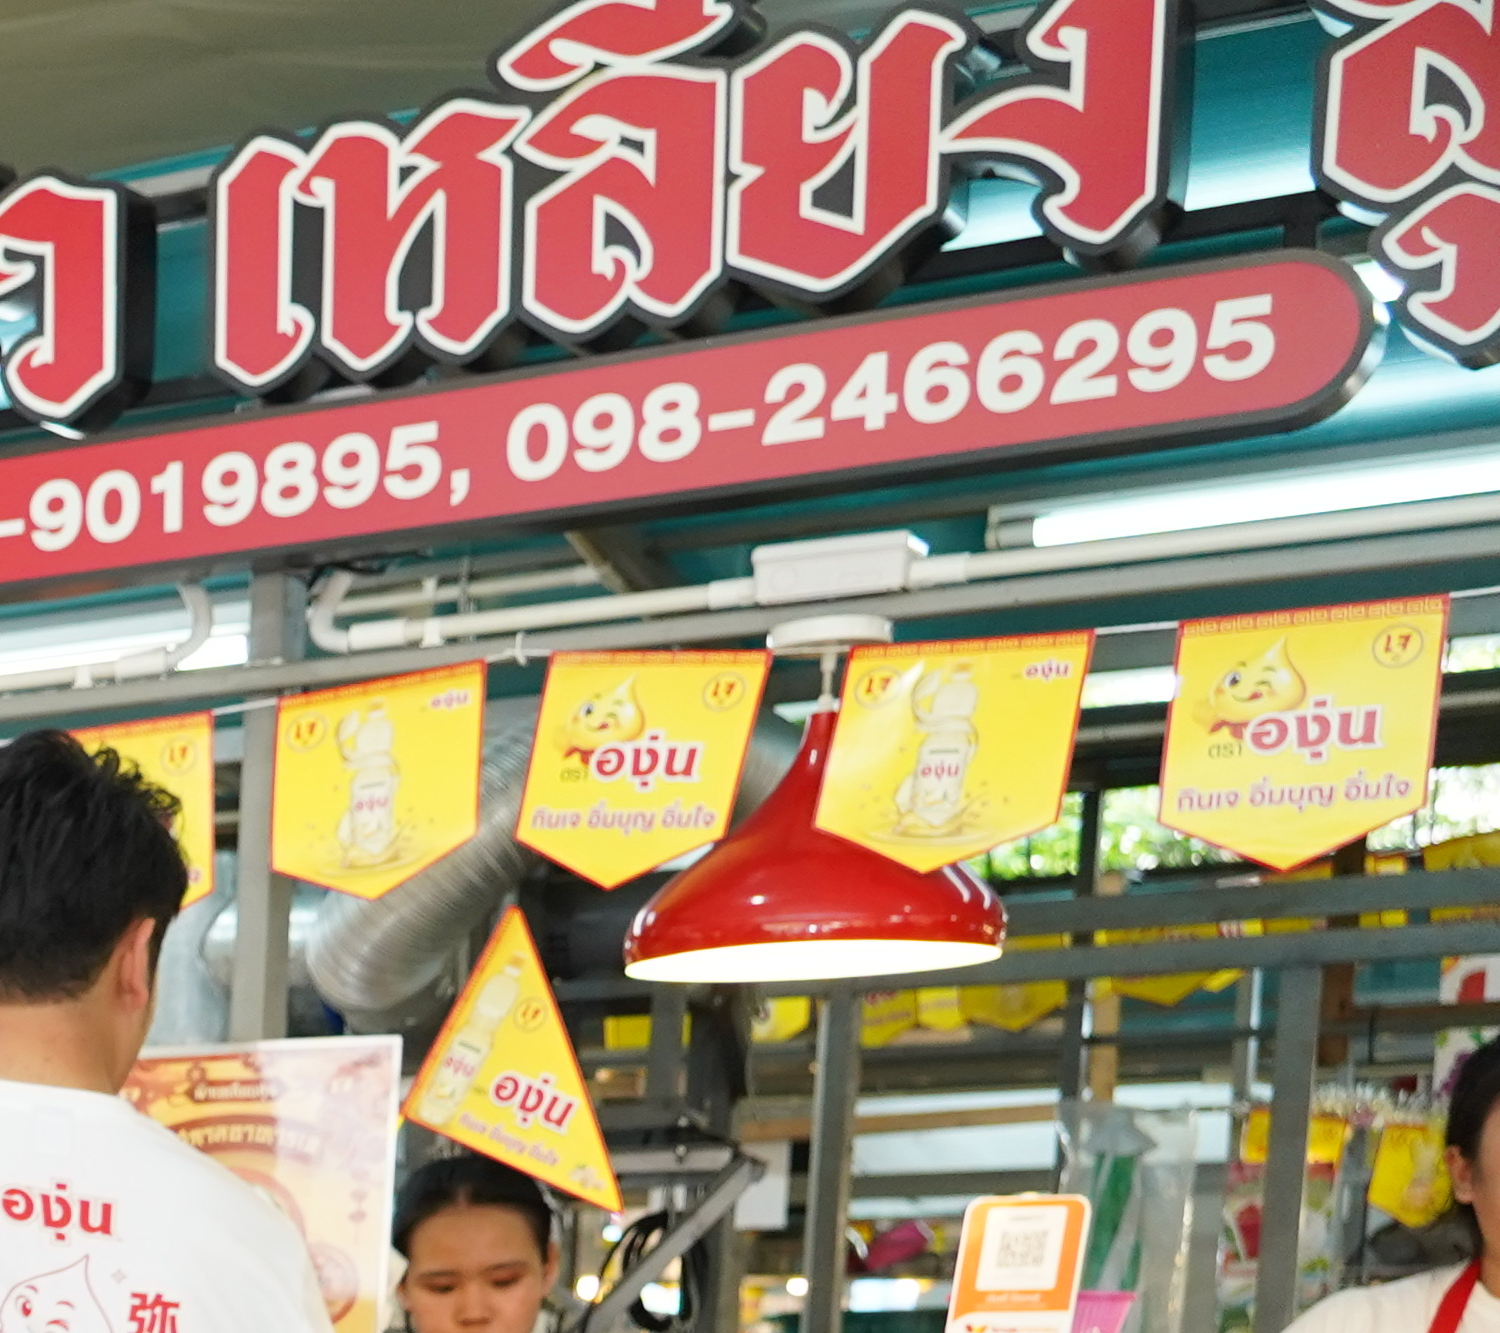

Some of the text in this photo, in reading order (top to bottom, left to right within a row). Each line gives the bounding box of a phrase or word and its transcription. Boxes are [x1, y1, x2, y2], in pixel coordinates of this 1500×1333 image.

[214, 0, 1167, 388] เหลียง
[505, 292, 1278, 484] 098-2466295
[1208, 699, 1379, 760] ตรา องุ่น
[596, 734, 698, 789] องุ่น
[1177, 769, 1412, 814] กินเจ อิ่มบุญ อิ่มใจ
[493, 1074, 575, 1129] องุ่น
[1, 1182, 114, 1242] องุ่น
